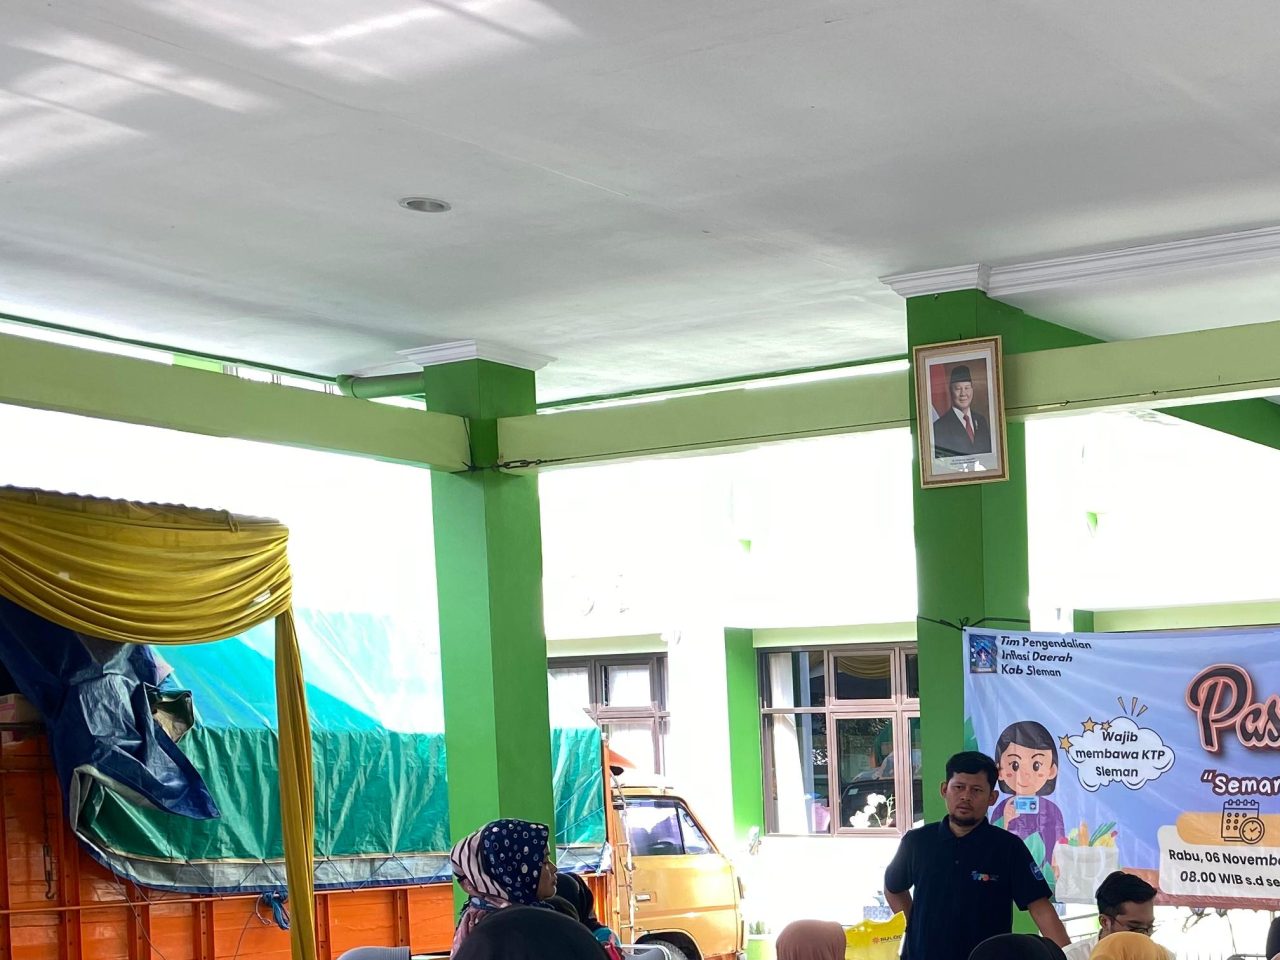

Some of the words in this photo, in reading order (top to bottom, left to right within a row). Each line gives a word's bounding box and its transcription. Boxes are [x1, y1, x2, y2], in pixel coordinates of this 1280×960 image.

[1001, 636, 1020, 646] Tim
[1022, 637, 1092, 650] Pengendalian
[1001, 650, 1030, 661] Inflasi
[1032, 652, 1073, 662] Daerah
[1001, 664, 1023, 674] Kab
[1026, 665, 1061, 677] Sleman
[1102, 731, 1138, 745] Wajib
[1075, 749, 1139, 759] membawa
[1141, 750, 1165, 760] KTP
[1095, 766, 1138, 777] Sleman
[1168, 849, 1203, 863] Rabu,
[1205, 852, 1220, 863] 06
[1180, 870, 1217, 883] 08.00
[1219, 873, 1243, 885] WIB
[1245, 875, 1264, 886] s.d
